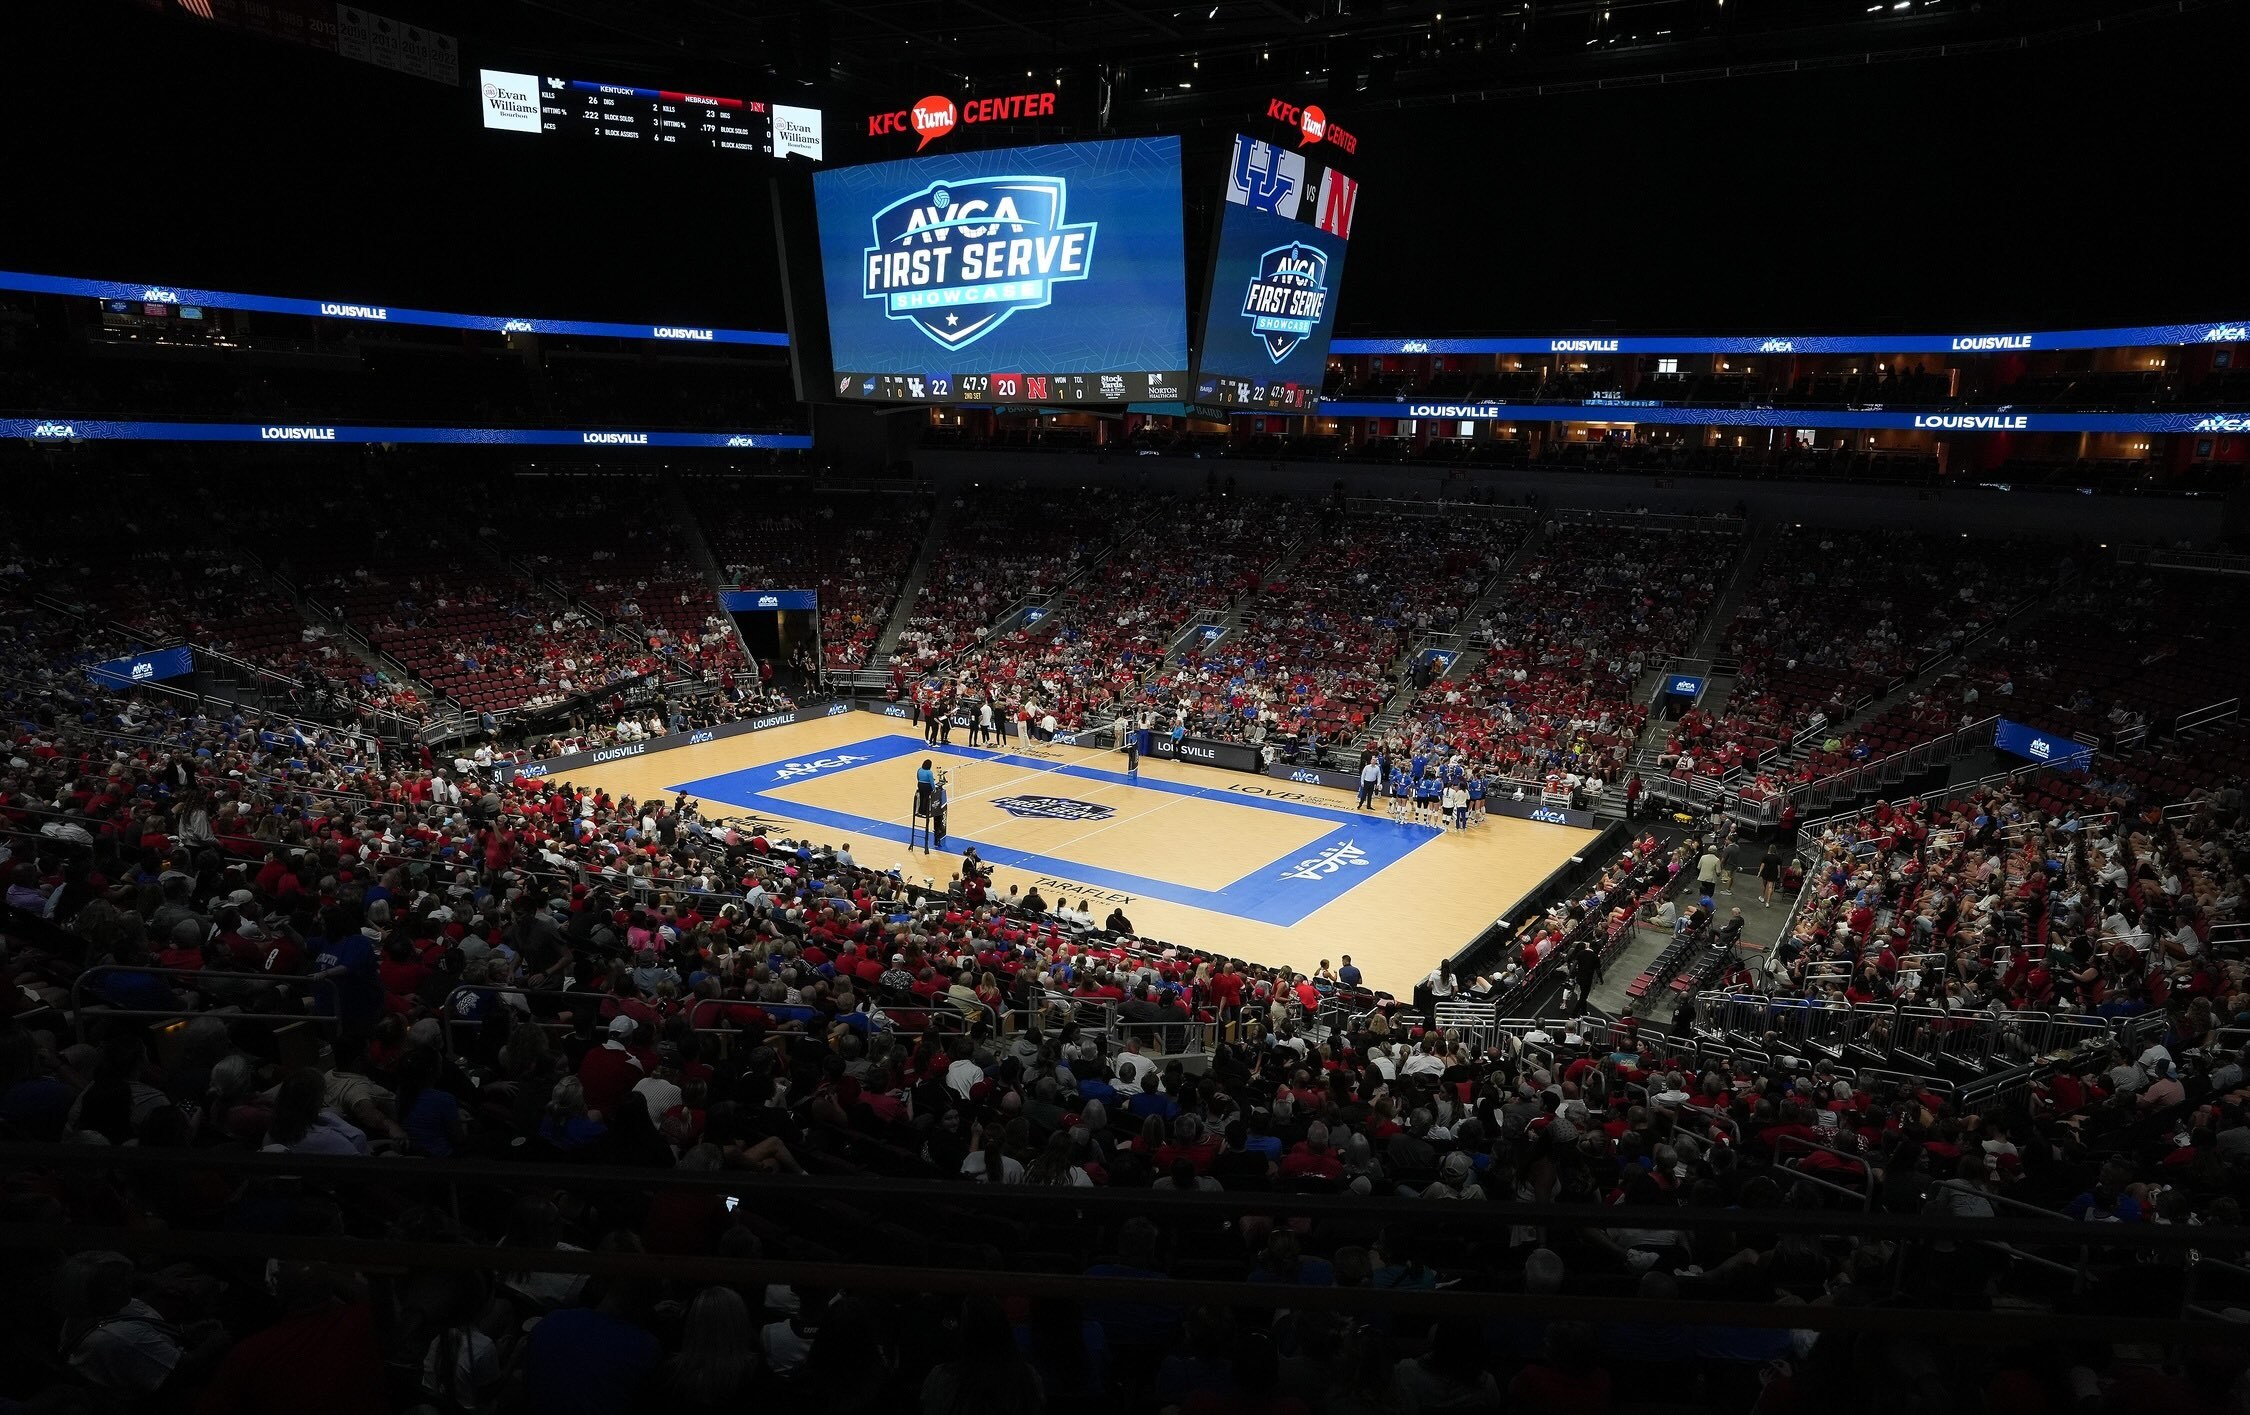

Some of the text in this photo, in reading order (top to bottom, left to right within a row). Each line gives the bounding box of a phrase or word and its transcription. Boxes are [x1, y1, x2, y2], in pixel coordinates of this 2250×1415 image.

[340, 23, 367, 41] 2009
[372, 31, 398, 49] 2013
[402, 40, 428, 58] 2018
[431, 48, 456, 65] 2022
[497, 88, 527, 101] Evan
[600, 86, 634, 96] KENTUCKY
[489, 99, 538, 114] Williams
[588, 97, 598, 105] 26
[603, 98, 615, 106] DIGS
[685, 96, 719, 106] NEBRASKA
[542, 107, 561, 115] HITTING
[652, 104, 658, 112] 2
[662, 105, 676, 113] KILLS
[706, 110, 715, 118] 23
[868, 92, 1056, 137] KFC Yum! CENTER
[500, 111, 528, 119] Bourbon
[583, 111, 599, 120] .222
[604, 113, 634, 123] BLOCK SOLOS
[543, 122, 556, 130] ACES
[653, 118, 659, 126] 3
[663, 120, 681, 128] HITTING
[700, 124, 716, 133] .179
[786, 121, 811, 133] Evan
[1266, 97, 1358, 155] KFC Yum! CENTER
[594, 128, 600, 136] 2
[605, 129, 639, 139] BLOCK ASSISTS
[654, 133, 660, 142] 6
[721, 126, 749, 136] BLOCK SOLOS
[766, 131, 771, 139] 0
[664, 135, 676, 143] ACES
[780, 131, 820, 145] Williams
[721, 141, 753, 151] BLOCK ASSISTS
[763, 145, 772, 153] 10
[1306, 183, 1317, 203] VS
[902, 195, 1024, 246] AVCA
[867, 231, 1085, 290] FIRST SERVE
[1271, 255, 1316, 287] AVCA
[143, 290, 181, 304] AVCA
[897, 283, 1036, 310] SHOWCASE
[1247, 286, 1324, 319] FIRST SERVE
[321, 303, 387, 320] LOUISVILLE
[504, 321, 533, 333] AVCA
[1259, 317, 1310, 332] SHOWCASE
[653, 328, 713, 341] LOUISVILLE
[2204, 328, 2246, 342] AVCA
[1402, 342, 1428, 354] AVCA
[1551, 340, 1618, 352] LOUISVILLE
[1760, 340, 1793, 352] AVCA
[1952, 335, 2032, 351] LOUISVILLE
[962, 376, 988, 391] 47.9
[1054, 376, 1083, 384] WON TOL
[1100, 375, 1123, 383] Stock
[897, 388, 903, 398] 0
[932, 379, 948, 396] 22
[998, 380, 1016, 396] 20
[1253, 386, 1265, 401] 22
[1270, 386, 1285, 399] 47.9
[964, 392, 981, 400] 2ND SET
[1058, 390, 1083, 399] 1 0
[1227, 393, 1233, 403] 0
[1285, 390, 1295, 404] 20
[1196, 406, 1223, 419] BAIRD
[1409, 405, 1498, 418] LOUISVILLE
[1914, 415, 2028, 429] LOUISVILLE
[34, 423, 76, 438] AVCA
[261, 427, 335, 440] LOUISVILLE
[583, 433, 648, 444] LOUISVILLE
[727, 437, 754, 447] AVCA
[131, 663, 153, 675] AVCA
[828, 704, 849, 716] AVCA
[884, 707, 906, 718] AVCA
[753, 713, 795, 730] LOUISVILLE
[689, 731, 714, 745] AVCA
[1052, 733, 1077, 746] AVCA
[593, 743, 645, 763] LOUISVILLE
[2030, 740, 2050, 754] AVCA
[773, 754, 870, 781] AVCA
[494, 769, 503, 783] 51
[1290, 771, 1321, 785] AVCA
[1227, 784, 1305, 800] LOVB
[995, 797, 1050, 810] FIRST
[1049, 806, 1109, 820] SERVE
[1036, 798, 1093, 812] AVCA
[1529, 809, 1566, 825] AVCA
[1280, 840, 1367, 881] AVCA
[1034, 877, 1137, 905] TARAFLEX
[264, 948, 280, 971] 8
